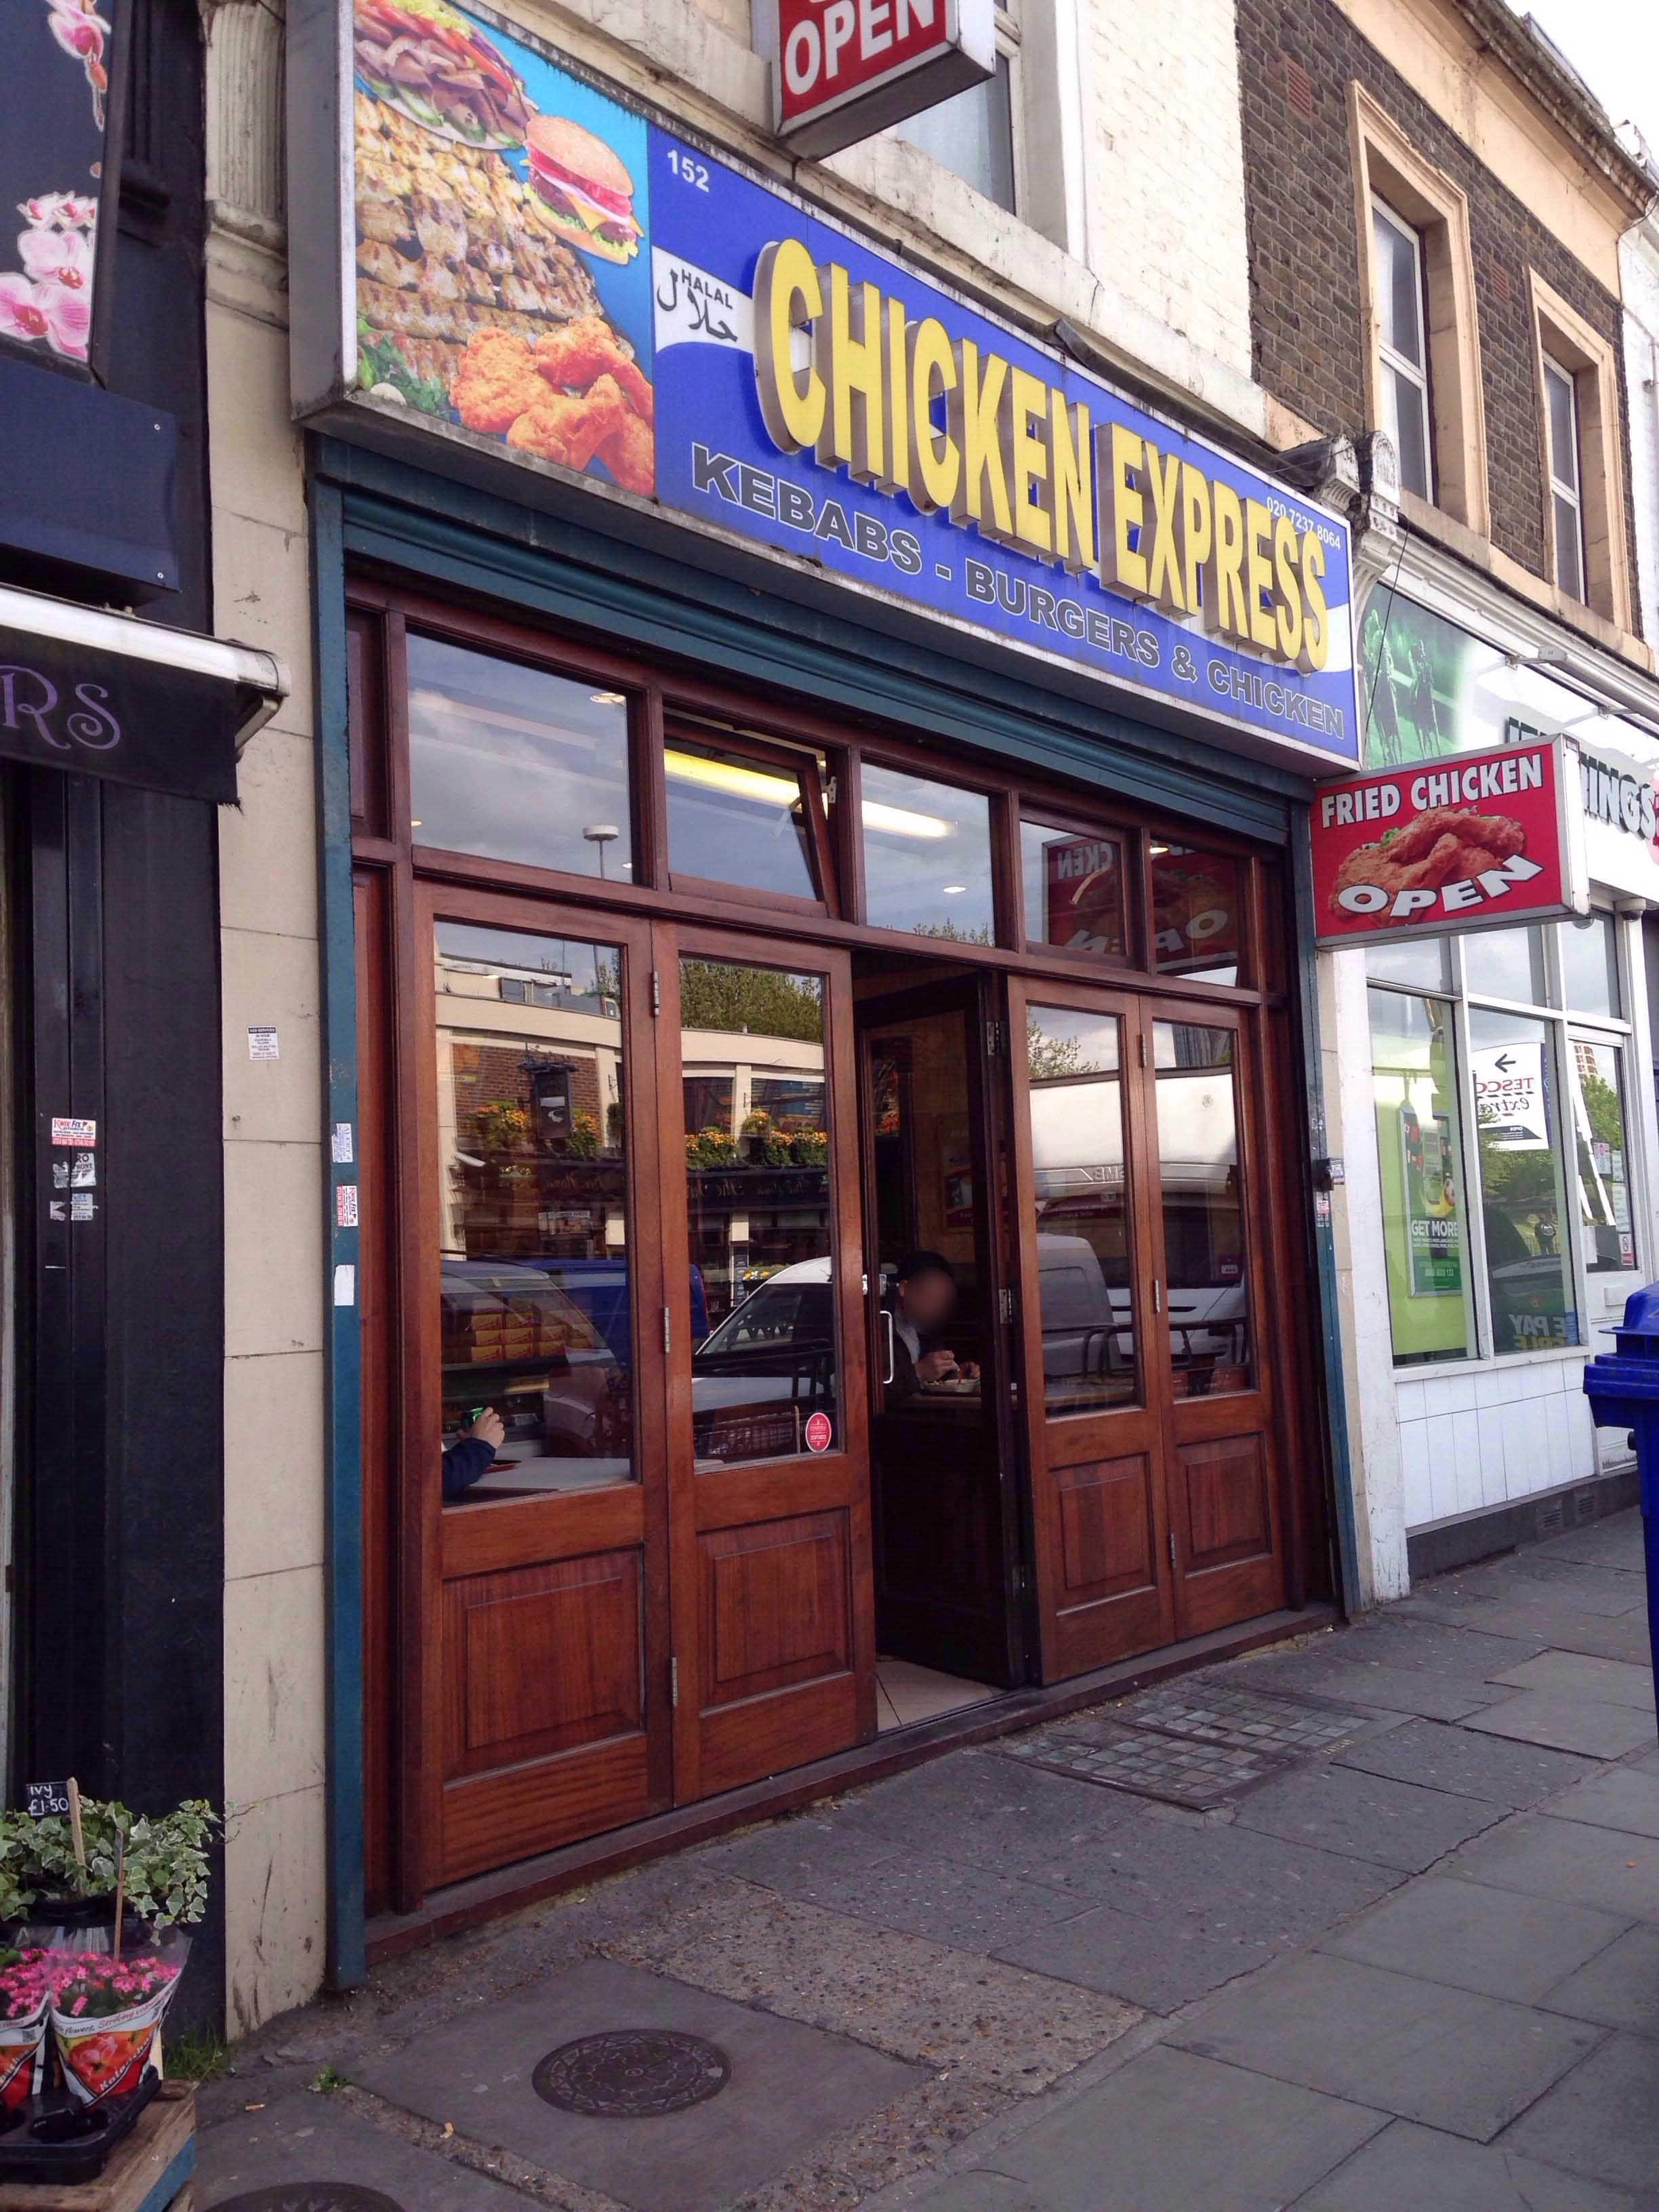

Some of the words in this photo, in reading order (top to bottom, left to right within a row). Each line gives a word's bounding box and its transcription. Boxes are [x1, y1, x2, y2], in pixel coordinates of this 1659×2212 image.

[785, 0, 935, 96] OPEN
[667, 149, 710, 192] 152
[680, 268, 733, 309] HALAL
[759, 239, 1094, 571] CHICKEN
[1103, 422, 1328, 672] EXPRESS
[1267, 496, 1286, 517] 020
[1289, 508, 1314, 531] 7237
[1317, 524, 1341, 550] 8064
[692, 442, 922, 575] KEBABS
[966, 558, 1161, 668] BURGERS
[1172, 646, 1198, 683] &
[1207, 659, 1345, 739] CHICKEN
[1322, 785, 1401, 828] FRIED
[1410, 753, 1543, 812] CHICKEN
[1338, 854, 1544, 917] OPEN
[1412, 1220, 1430, 1236] GET
[1431, 1221, 1458, 1237] MORE
